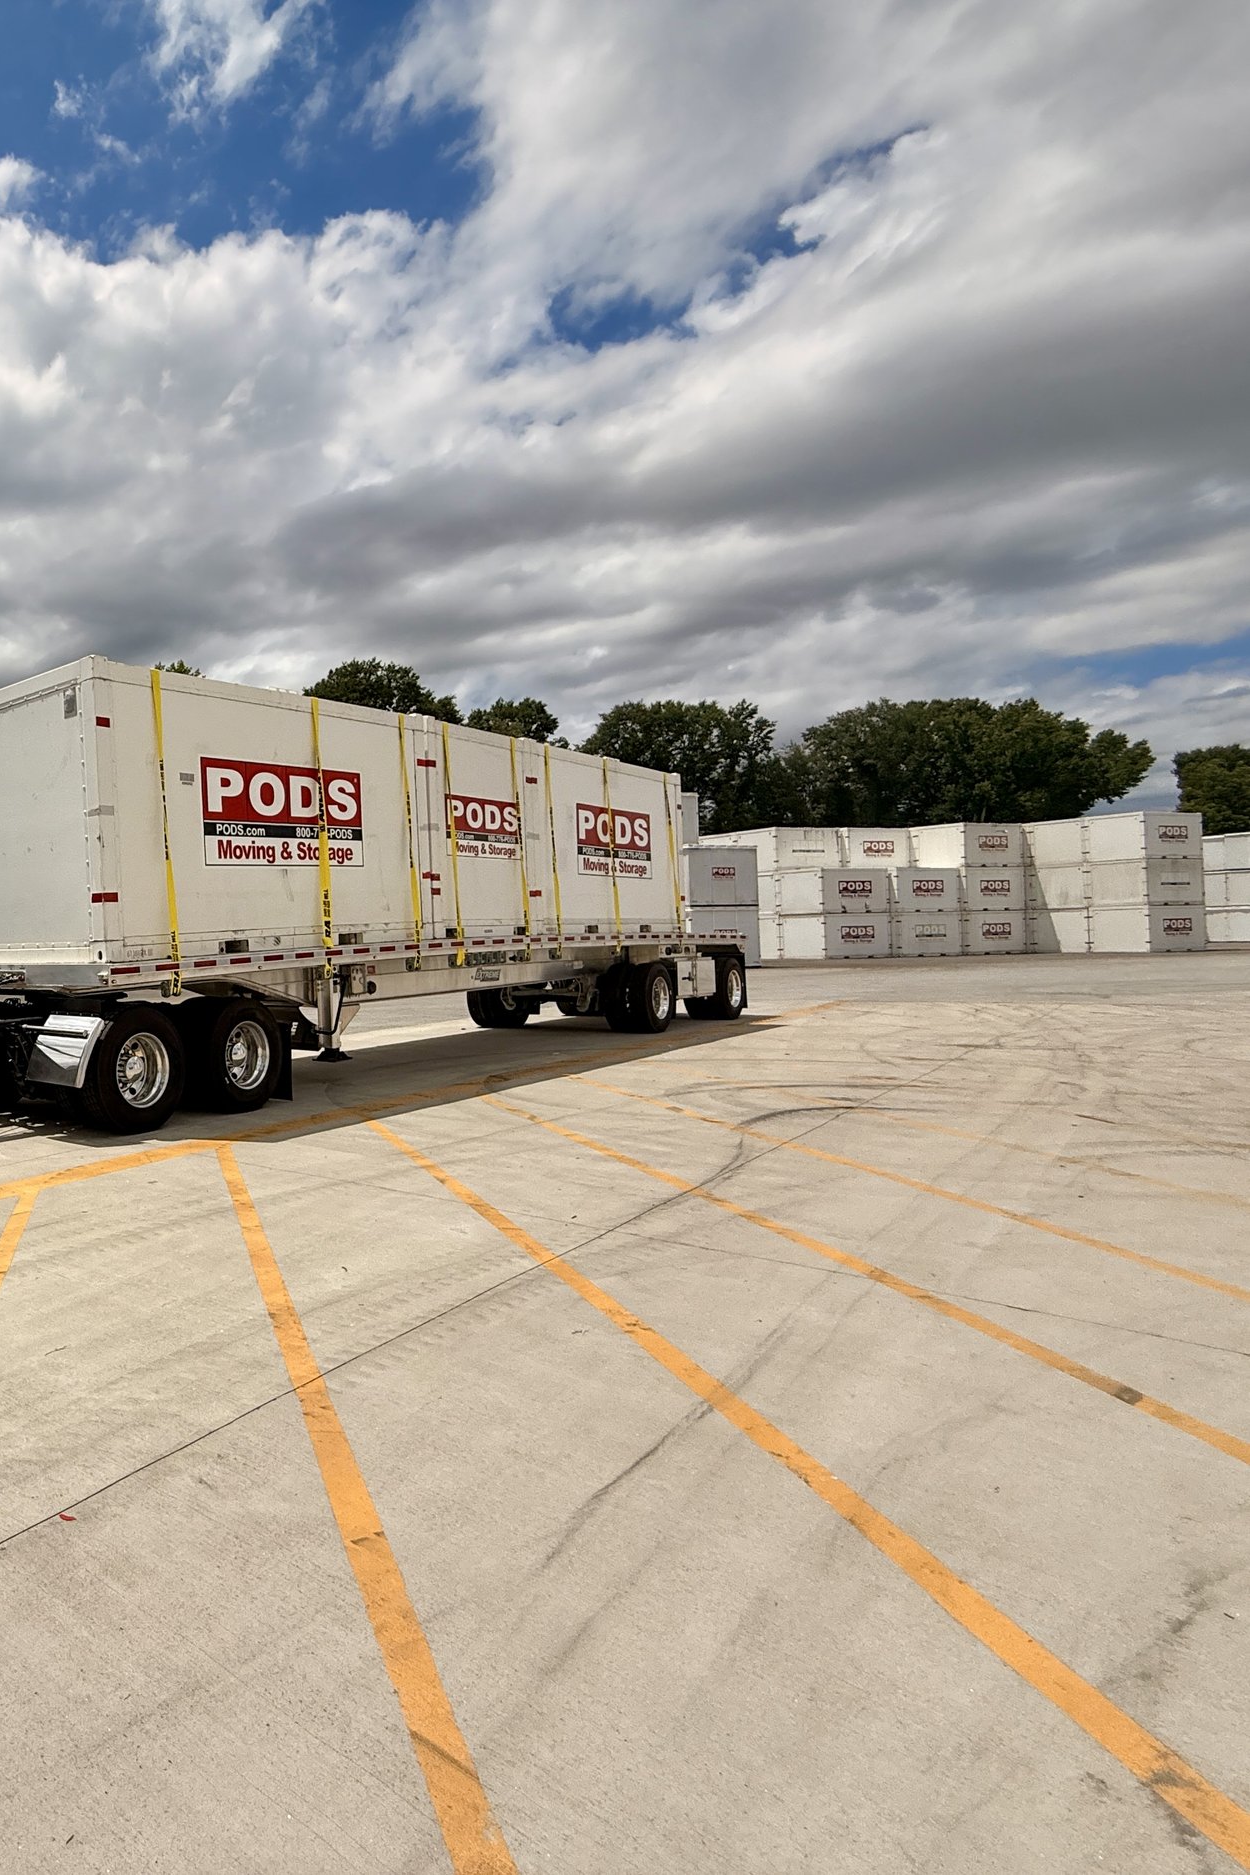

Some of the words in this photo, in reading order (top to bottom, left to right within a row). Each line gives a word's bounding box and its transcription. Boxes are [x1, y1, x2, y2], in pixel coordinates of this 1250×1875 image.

[206, 766, 358, 821] PODS
[447, 799, 518, 832] PODS
[216, 824, 266, 837] PODS.com
[296, 827, 353, 840] 800-7-PODS
[578, 809, 649, 847] PODS
[1159, 826, 1187, 835] PODS
[979, 836, 1007, 845] PODS
[481, 843, 487, 855] &
[488, 844, 516, 858] Storage
[863, 842, 894, 850] PODS
[217, 839, 276, 864] Moving
[280, 841, 293, 861] &
[297, 841, 354, 865] Stoage
[583, 857, 610, 875] Moving
[618, 860, 647, 877] Storage
[840, 881, 871, 890] PODS
[913, 881, 943, 890] PODS
[981, 881, 1009, 890] PODS
[983, 923, 1010, 932] PODS
[1163, 919, 1191, 928] PODS
[841, 926, 874, 935] PODS
